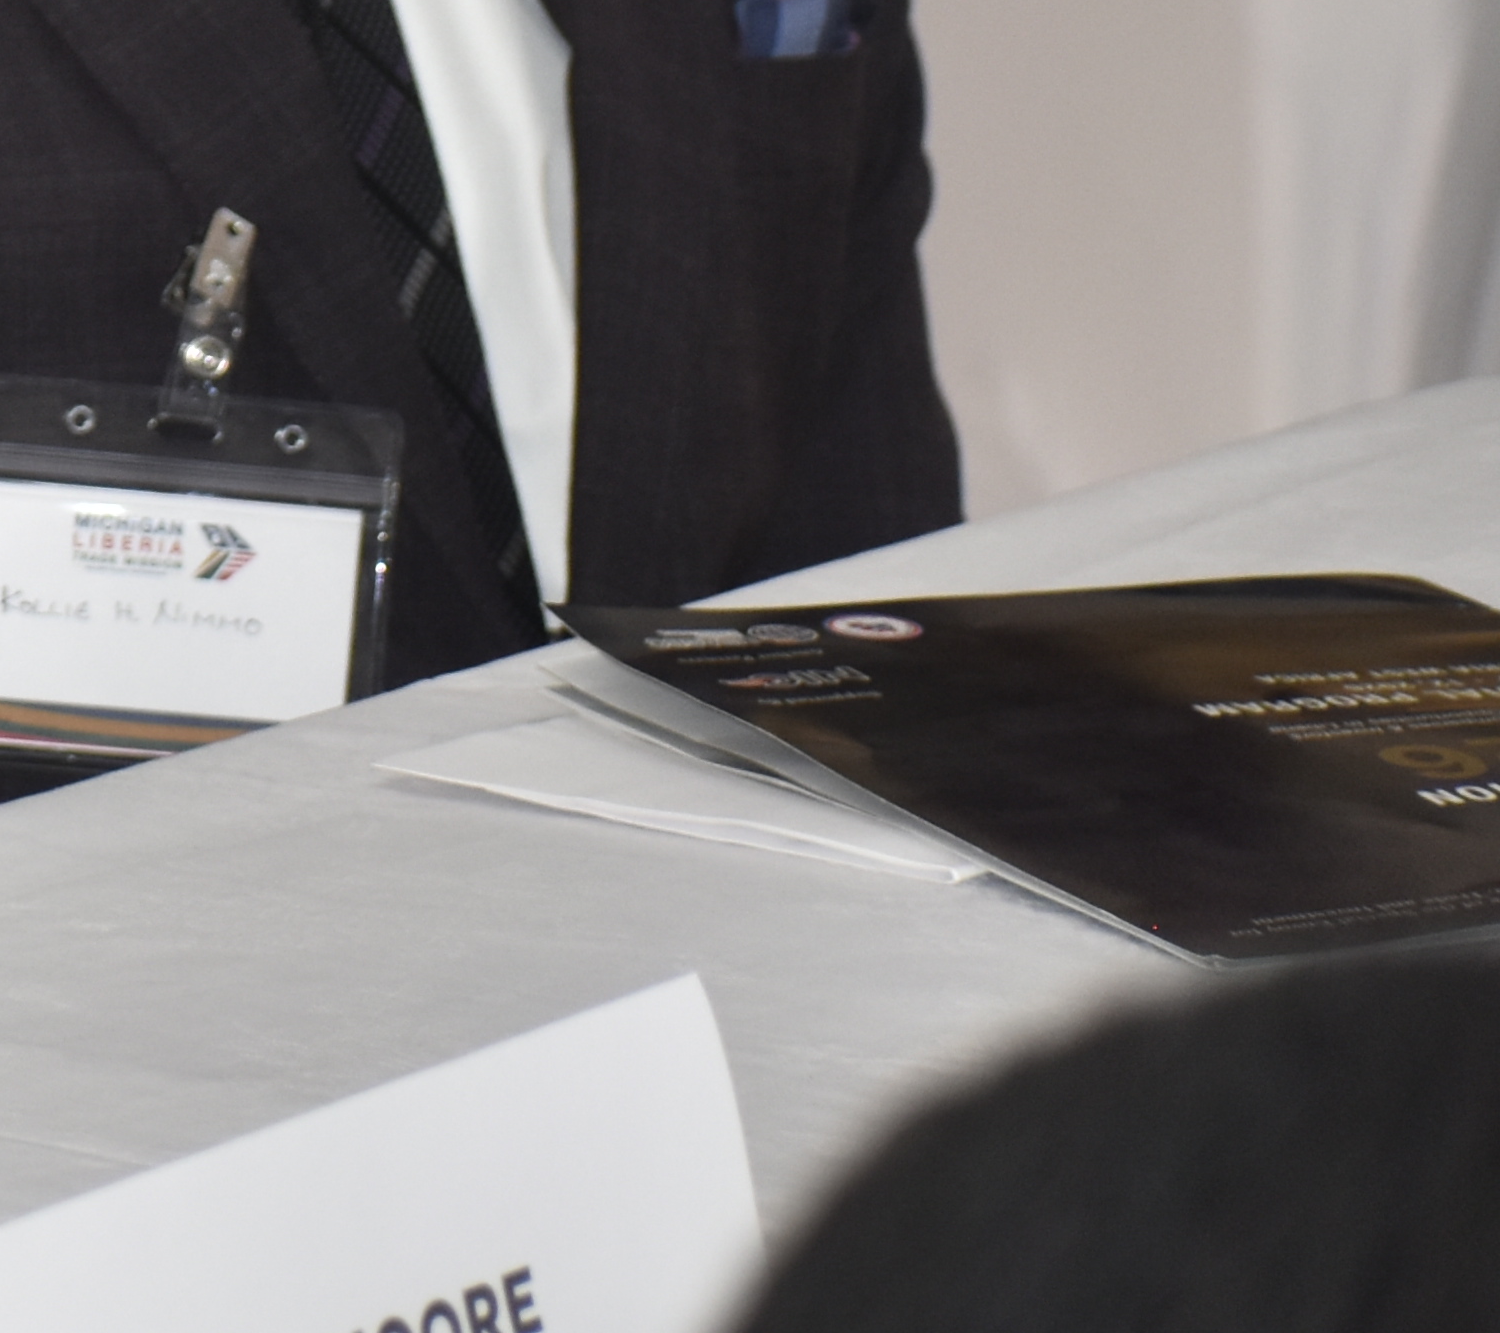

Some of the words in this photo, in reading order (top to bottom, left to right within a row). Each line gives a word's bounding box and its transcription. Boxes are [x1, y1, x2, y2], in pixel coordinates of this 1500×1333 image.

[74, 513, 184, 534] MICHIGAN
[72, 533, 183, 555] LIBERIA
[1192, 689, 1419, 717] PROGRAM
